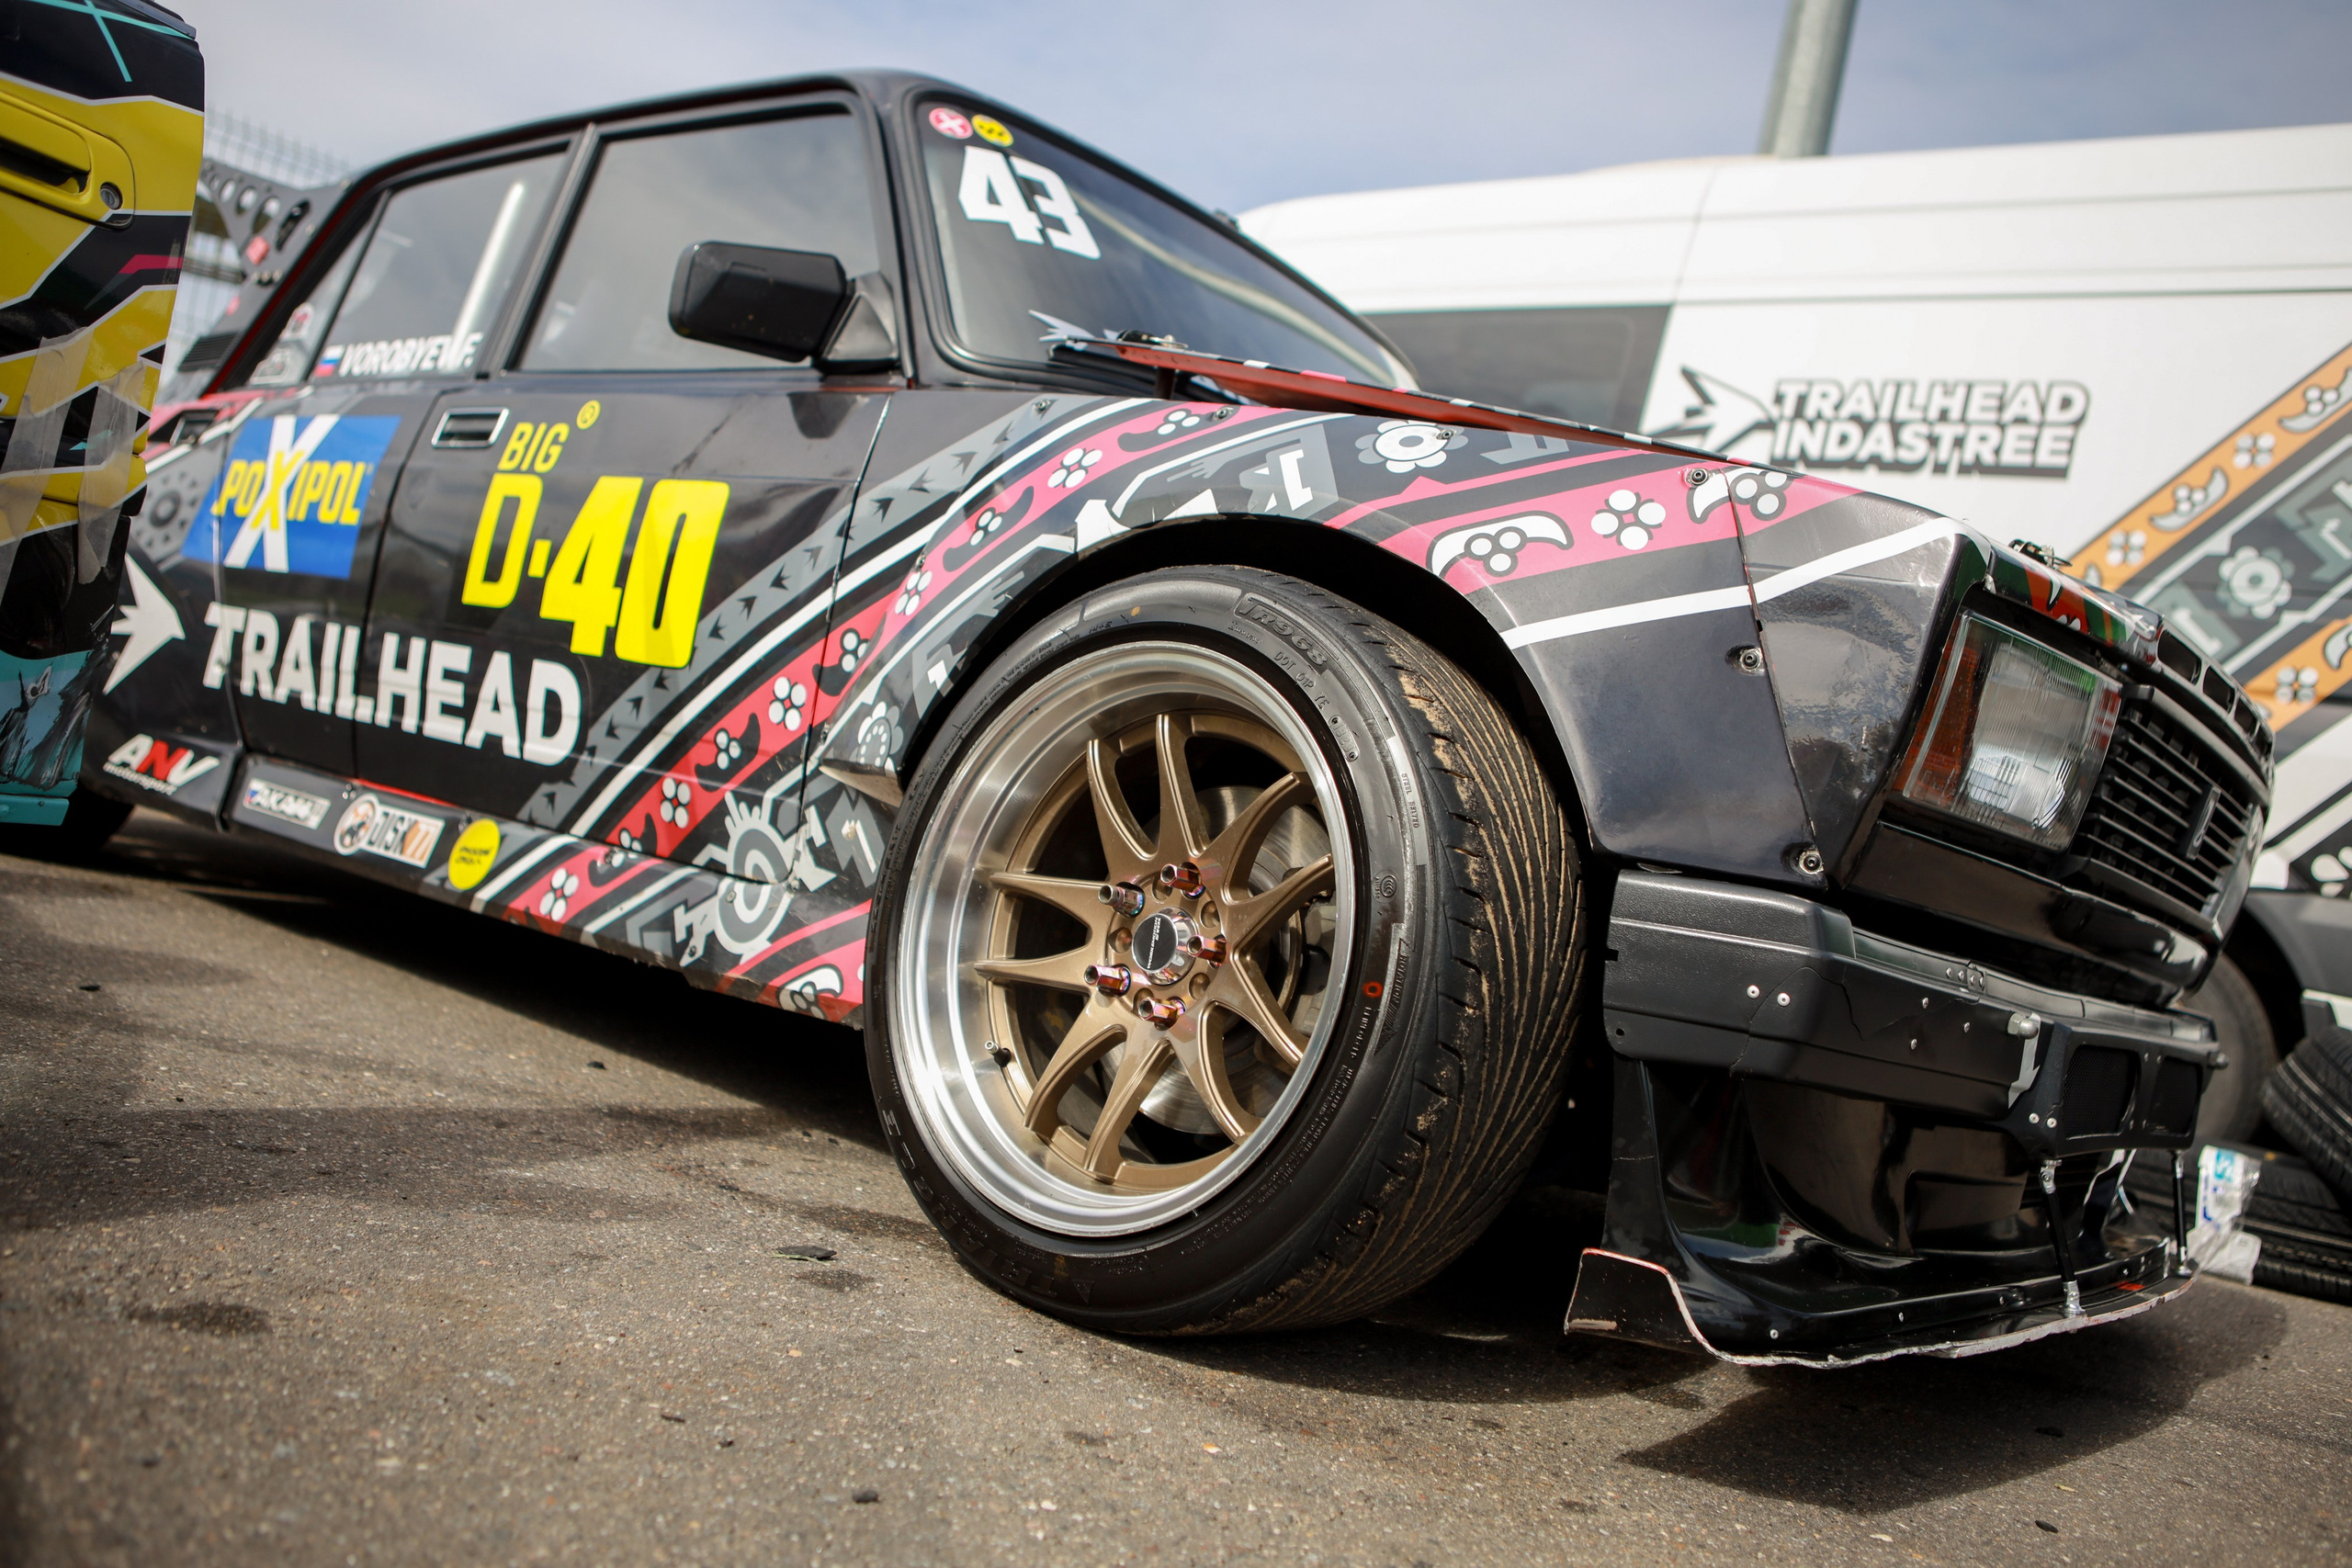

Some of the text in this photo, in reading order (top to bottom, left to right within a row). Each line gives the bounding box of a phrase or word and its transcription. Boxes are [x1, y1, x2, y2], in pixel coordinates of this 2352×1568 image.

[958, 145, 1100, 259] 43
[1775, 378, 2089, 424] TRAILHEAD
[497, 423, 570, 473] BIG
[1772, 419, 2075, 467] INDASTREE
[210, 448, 368, 531] POXIPOL
[461, 472, 729, 670] D-40
[1238, 597, 1328, 666] TR968
[1274, 651, 1296, 671] DOT
[202, 602, 581, 766] TRAILHEAD
[107, 733, 220, 787] ANV
